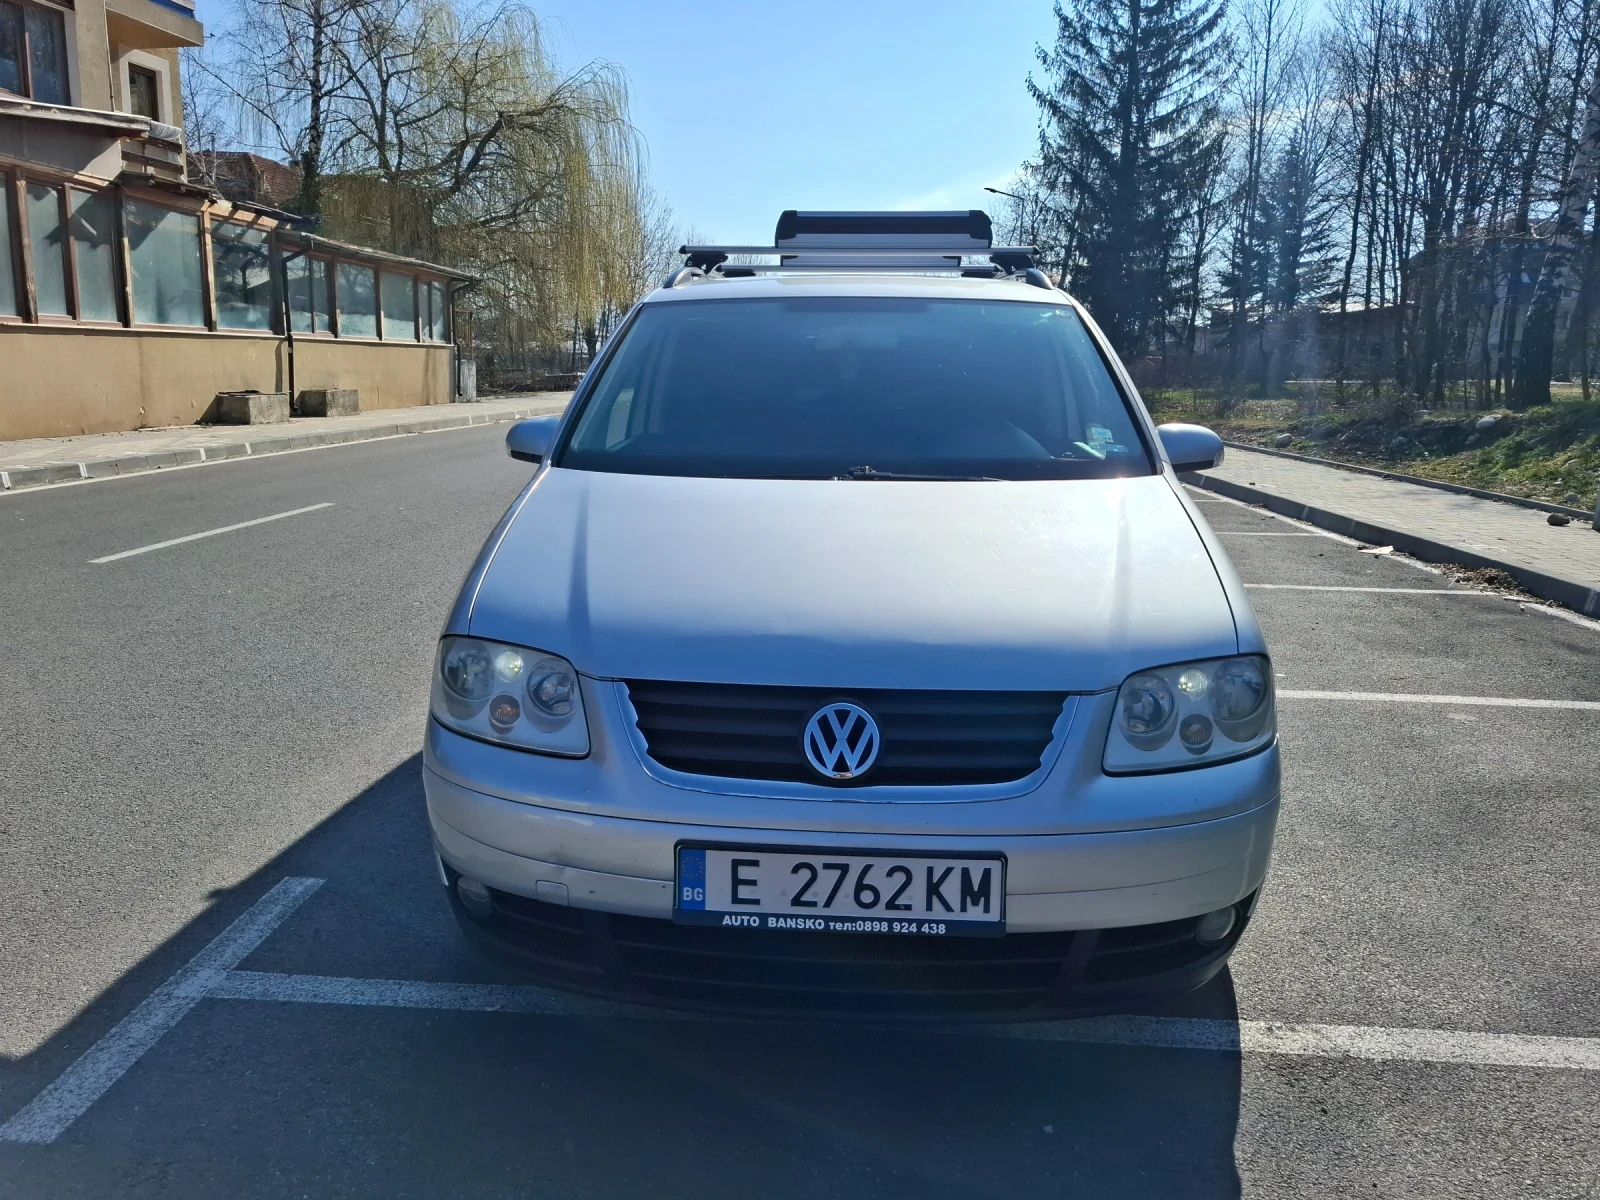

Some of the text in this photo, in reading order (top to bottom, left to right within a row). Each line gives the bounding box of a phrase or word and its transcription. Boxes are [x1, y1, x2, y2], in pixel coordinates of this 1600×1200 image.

[804, 703, 880, 779] VW
[682, 886, 704, 902] BG
[730, 858, 761, 906] E
[722, 914, 760, 927] AUTO
[767, 916, 825, 930] BANSKO
[892, 922, 918, 933] 924
[921, 923, 947, 934] 438
